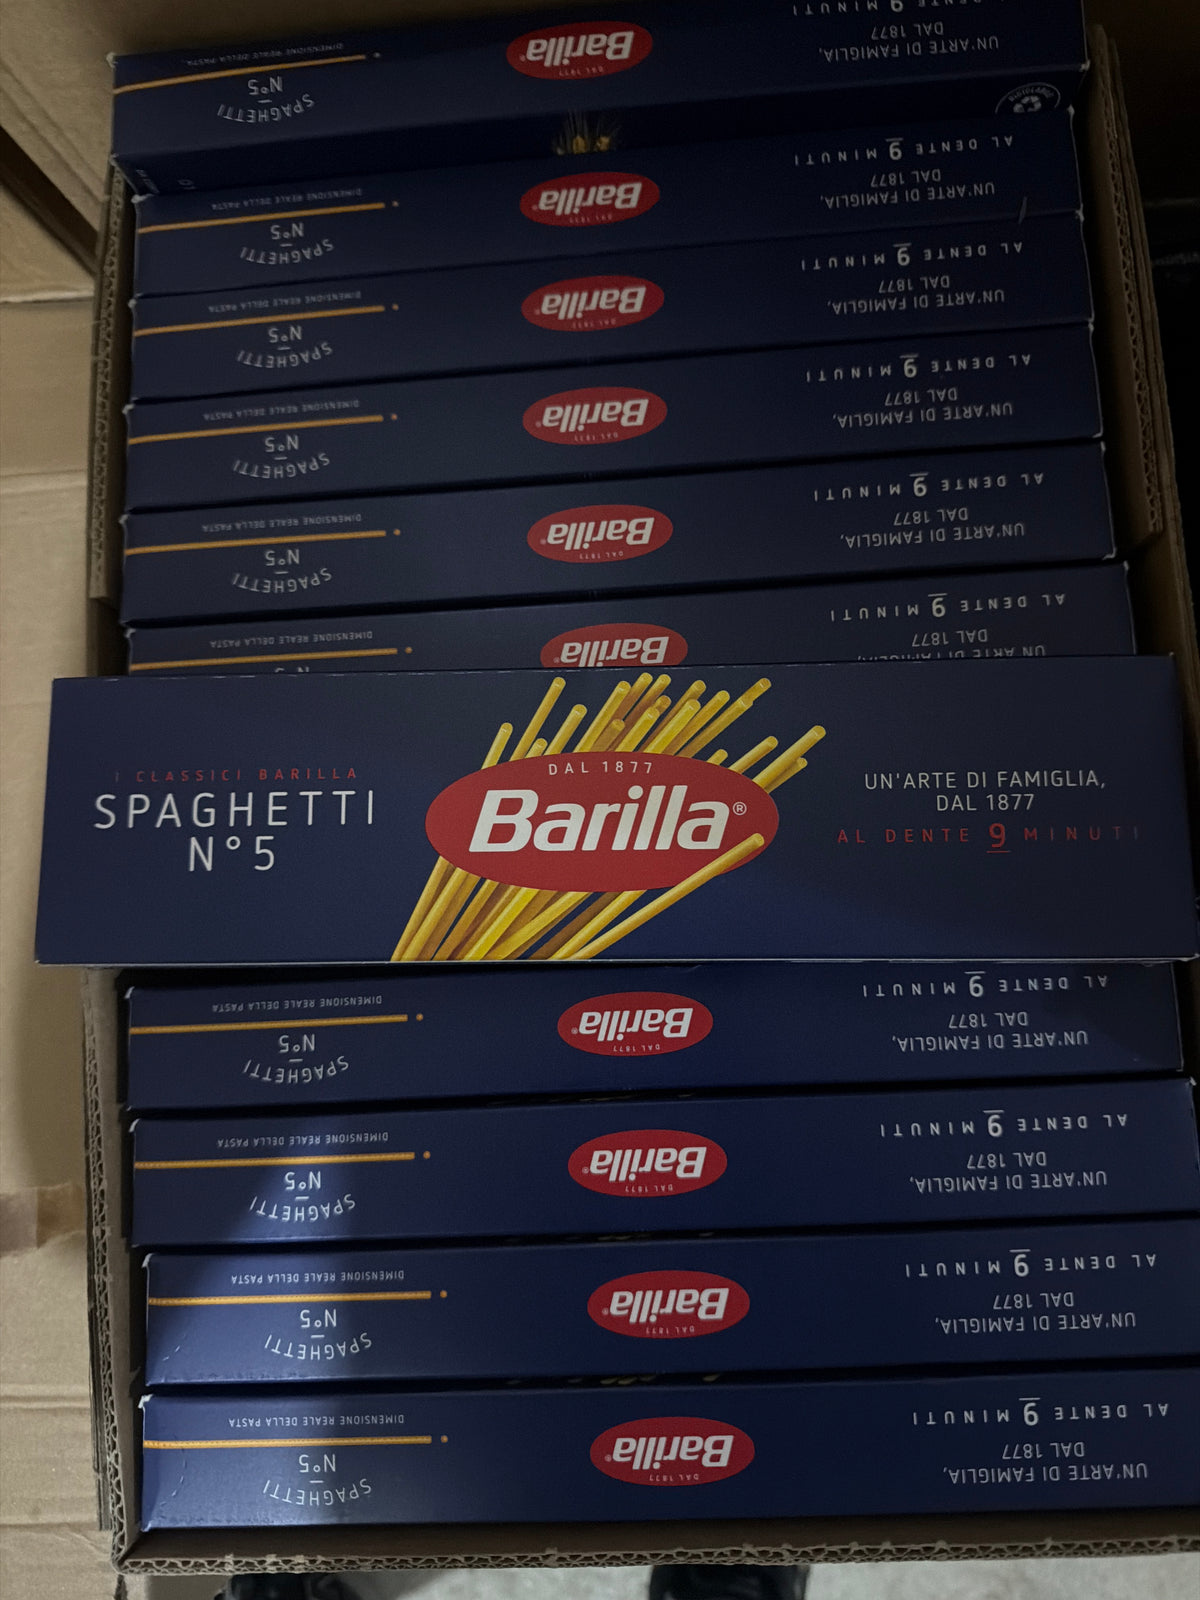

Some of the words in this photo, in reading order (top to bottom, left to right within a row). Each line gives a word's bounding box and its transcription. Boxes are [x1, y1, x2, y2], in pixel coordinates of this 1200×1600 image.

[871, 24, 907, 40] 1877
[912, 21, 943, 35] DAL
[907, 41, 922, 55] DI
[929, 34, 998, 53] UN'ARTE
[217, 94, 315, 123] SPAGHETTI
[915, 138, 978, 154] DENTE
[991, 135, 1012, 147] AL
[794, 148, 877, 166] MINUTI
[889, 142, 902, 160] 9
[871, 172, 905, 187] 1877
[911, 169, 941, 183] DAL
[905, 188, 920, 201] DI
[927, 181, 994, 200] UN'ARTE
[240, 239, 333, 266] SPAGHETTI
[923, 244, 987, 260] DENTE
[1000, 241, 1022, 253] AL
[801, 253, 885, 271] MINUTI
[897, 247, 910, 266] 9
[879, 278, 914, 293] 1877
[920, 275, 950, 290] DAL
[914, 295, 928, 308] DI
[936, 288, 1004, 307] UN'ARTE
[237, 343, 332, 369] SPAGHETTI
[1009, 354, 1030, 366] AL
[903, 360, 917, 378] 9
[930, 357, 995, 373] DENTE
[806, 366, 891, 383] MINUTI
[885, 391, 921, 406] 1877
[927, 388, 957, 402] DAL
[921, 408, 936, 421] DI
[943, 402, 1013, 420] UN'ARTE
[233, 453, 329, 480] SPAGHETTI
[941, 476, 1006, 492] DENTE
[1020, 473, 1042, 486] AL
[814, 484, 901, 501] MINUTI
[913, 478, 927, 498] 9
[894, 511, 930, 526] 1877
[937, 508, 968, 523] DAL
[930, 529, 946, 542] DI
[953, 523, 1024, 541] UN'ARTE
[234, 567, 331, 594] SPAGHETTI
[932, 598, 947, 618] 9
[960, 597, 1027, 612] DENTE
[1041, 594, 1064, 606] AL
[832, 604, 920, 621] MINUTI
[913, 632, 950, 647] 1877
[956, 629, 988, 644] DAL
[136, 770, 242, 783] CLASSICI
[258, 767, 358, 781] BARILLA
[548, 760, 589, 776] DAL
[601, 760, 653, 775] 1877
[864, 770, 958, 791] UN'ARTE
[966, 770, 988, 790] DI
[996, 768, 1107, 790] FAMIGLIA,
[93, 789, 375, 830] SPAGHETTI
[936, 793, 978, 812] DAL
[985, 792, 1036, 812] 1877
[837, 828, 866, 844] AL
[885, 827, 971, 844] DENTE
[989, 822, 1006, 849] 9
[1023, 824, 1141, 842] MINUTI
[969, 976, 984, 997] 9
[998, 976, 1068, 992] DENTE
[1083, 974, 1107, 988] AL
[863, 982, 956, 998] MINUTI
[212, 1002, 243, 1012] PASTA
[248, 1001, 279, 1010] DELLA
[283, 999, 314, 1009] REALE
[319, 995, 381, 1007] DIMENSIONE
[949, 1013, 988, 1029] 1877
[994, 1011, 1027, 1027] DAL
[988, 1034, 1004, 1048] DI
[1012, 1030, 1088, 1048] UN'ARTE
[243, 1056, 348, 1084] SPAGHETTI
[987, 1115, 1003, 1137] 9
[1017, 1116, 1088, 1131] DENTE
[1103, 1114, 1127, 1127] AL
[880, 1121, 974, 1137] MINUTI
[217, 1138, 248, 1148] PASTA
[253, 1137, 284, 1146] DELLA
[289, 1135, 320, 1145] REALE
[326, 1132, 389, 1144] DIMENSIONE
[967, 1153, 1006, 1169] 1877
[1013, 1151, 1046, 1167] DAL
[1006, 1174, 1022, 1189] DI
[1031, 1171, 1107, 1189] UN'ARTE
[250, 1193, 356, 1222] SPAGHETTI
[905, 1260, 1000, 1277] MINUTI
[1014, 1254, 1029, 1277] 9
[1044, 1256, 1116, 1272] DENTE
[1131, 1254, 1156, 1268] AL
[230, 1275, 263, 1285] PASTA
[268, 1274, 299, 1284] DELLA
[304, 1272, 336, 1283] REALE
[341, 1269, 405, 1281] DIMENSIONE
[993, 1294, 1033, 1310] 1877
[1040, 1292, 1074, 1308] DAL
[1033, 1316, 1050, 1331] DI
[1058, 1313, 1136, 1331] UN'ARTE
[265, 1332, 372, 1361] SPAGHETTI
[913, 1409, 1010, 1425] MINUTI
[1024, 1403, 1039, 1426] 9
[1054, 1405, 1128, 1421] DENTE
[1143, 1404, 1168, 1418] AL
[228, 1419, 261, 1428] PASTA
[266, 1417, 298, 1427] DELLA
[303, 1416, 335, 1426] REALE
[340, 1414, 405, 1425] DIMENSIONE
[1002, 1443, 1043, 1459] 1877
[1050, 1442, 1084, 1458] DAL
[1043, 1465, 1060, 1481] DI
[1068, 1463, 1147, 1481] UN'ARTE
[264, 1477, 372, 1506] SPAGHETTI
